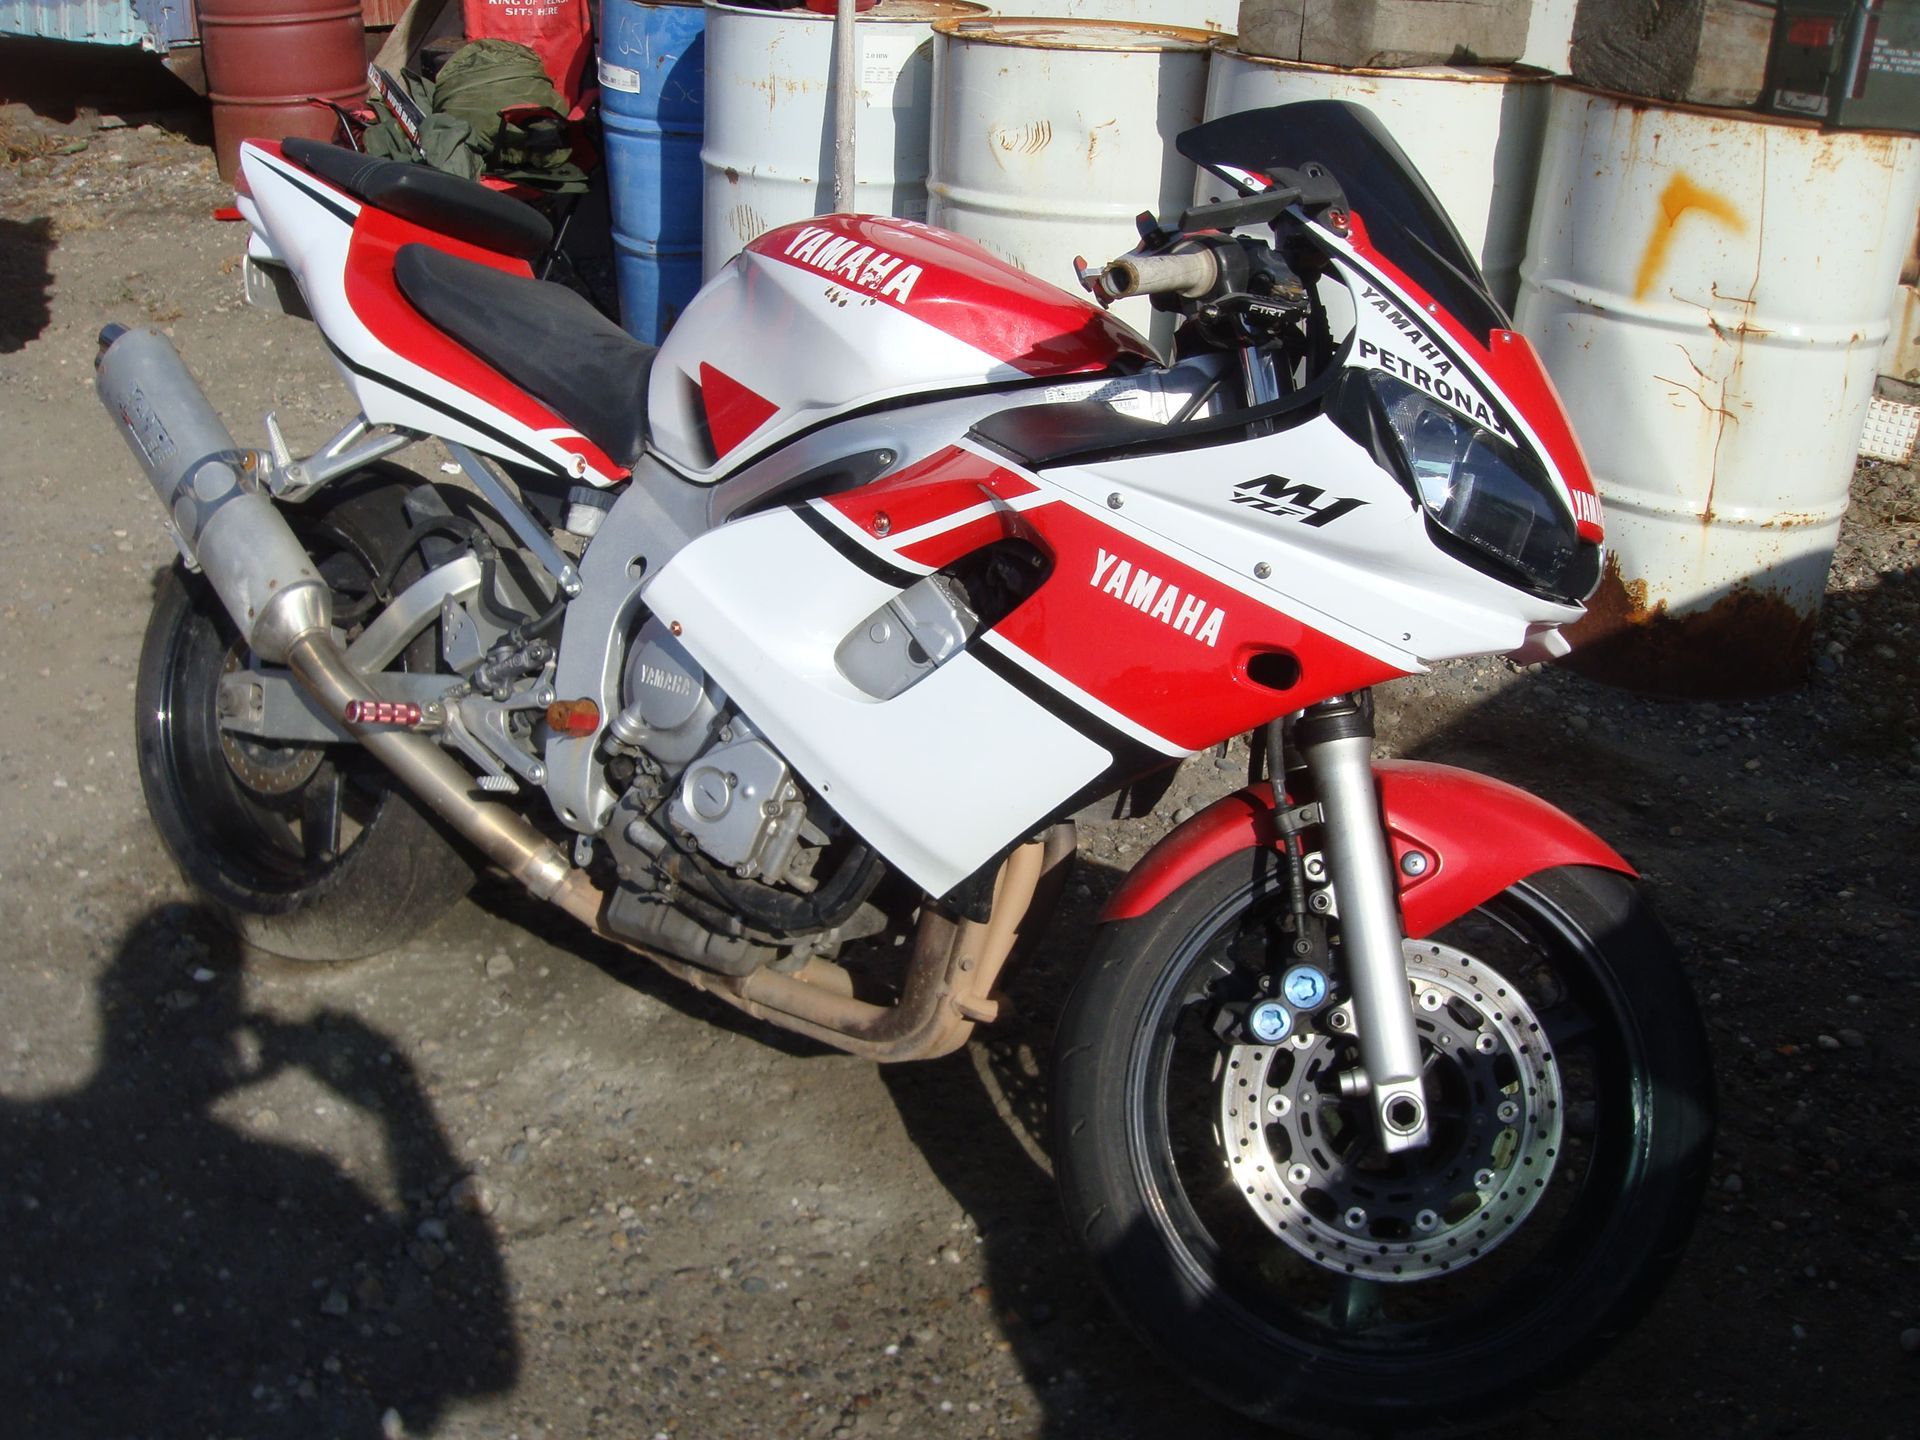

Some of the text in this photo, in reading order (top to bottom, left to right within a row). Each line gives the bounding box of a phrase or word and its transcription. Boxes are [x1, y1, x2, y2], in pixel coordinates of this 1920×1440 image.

[505, 8, 533, 16] SITS
[784, 226, 923, 304] YAMAHA
[1361, 286, 1453, 377] YAMAHA
[1090, 547, 1226, 648] YAMAHA
[641, 664, 690, 696] YAMAHA
